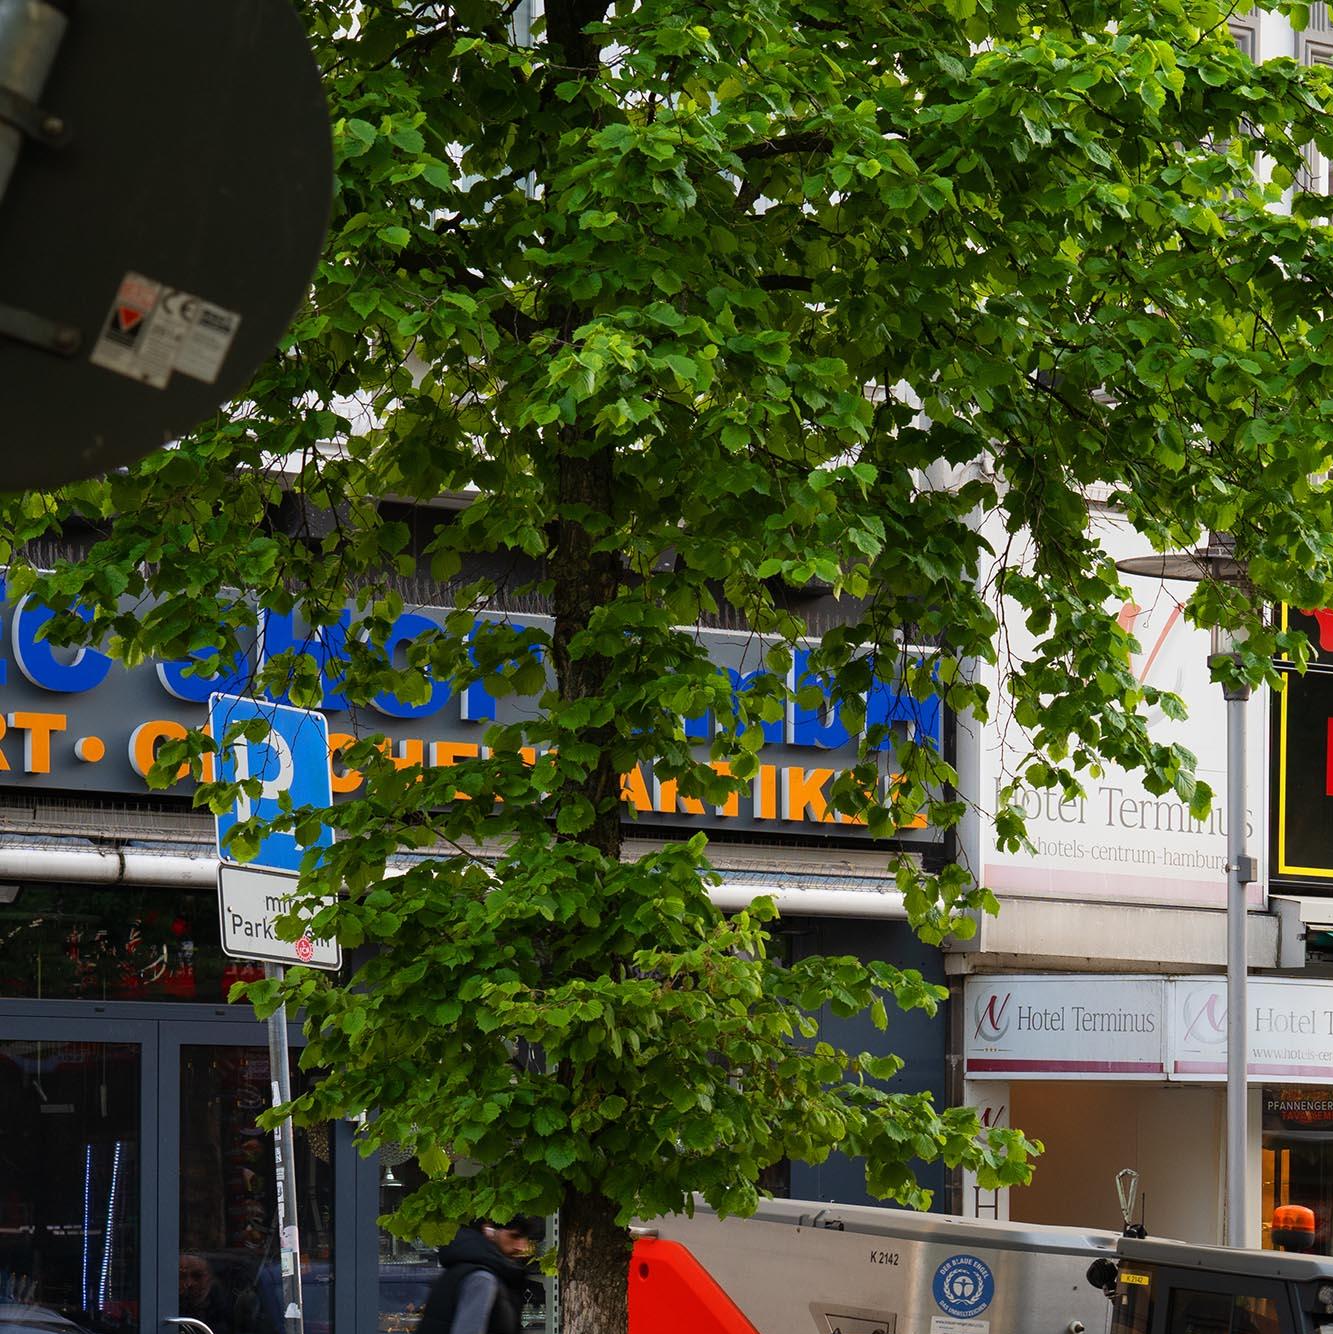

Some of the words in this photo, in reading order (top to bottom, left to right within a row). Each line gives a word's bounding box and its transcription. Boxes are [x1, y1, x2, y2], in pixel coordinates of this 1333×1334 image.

[232, 719, 293, 823] P
[1017, 1006, 1065, 1031] Hotel
[1071, 1007, 1155, 1033] Terminus
[1255, 1007, 1316, 1035] Hotel
[879, 1251, 899, 1266] 2142
